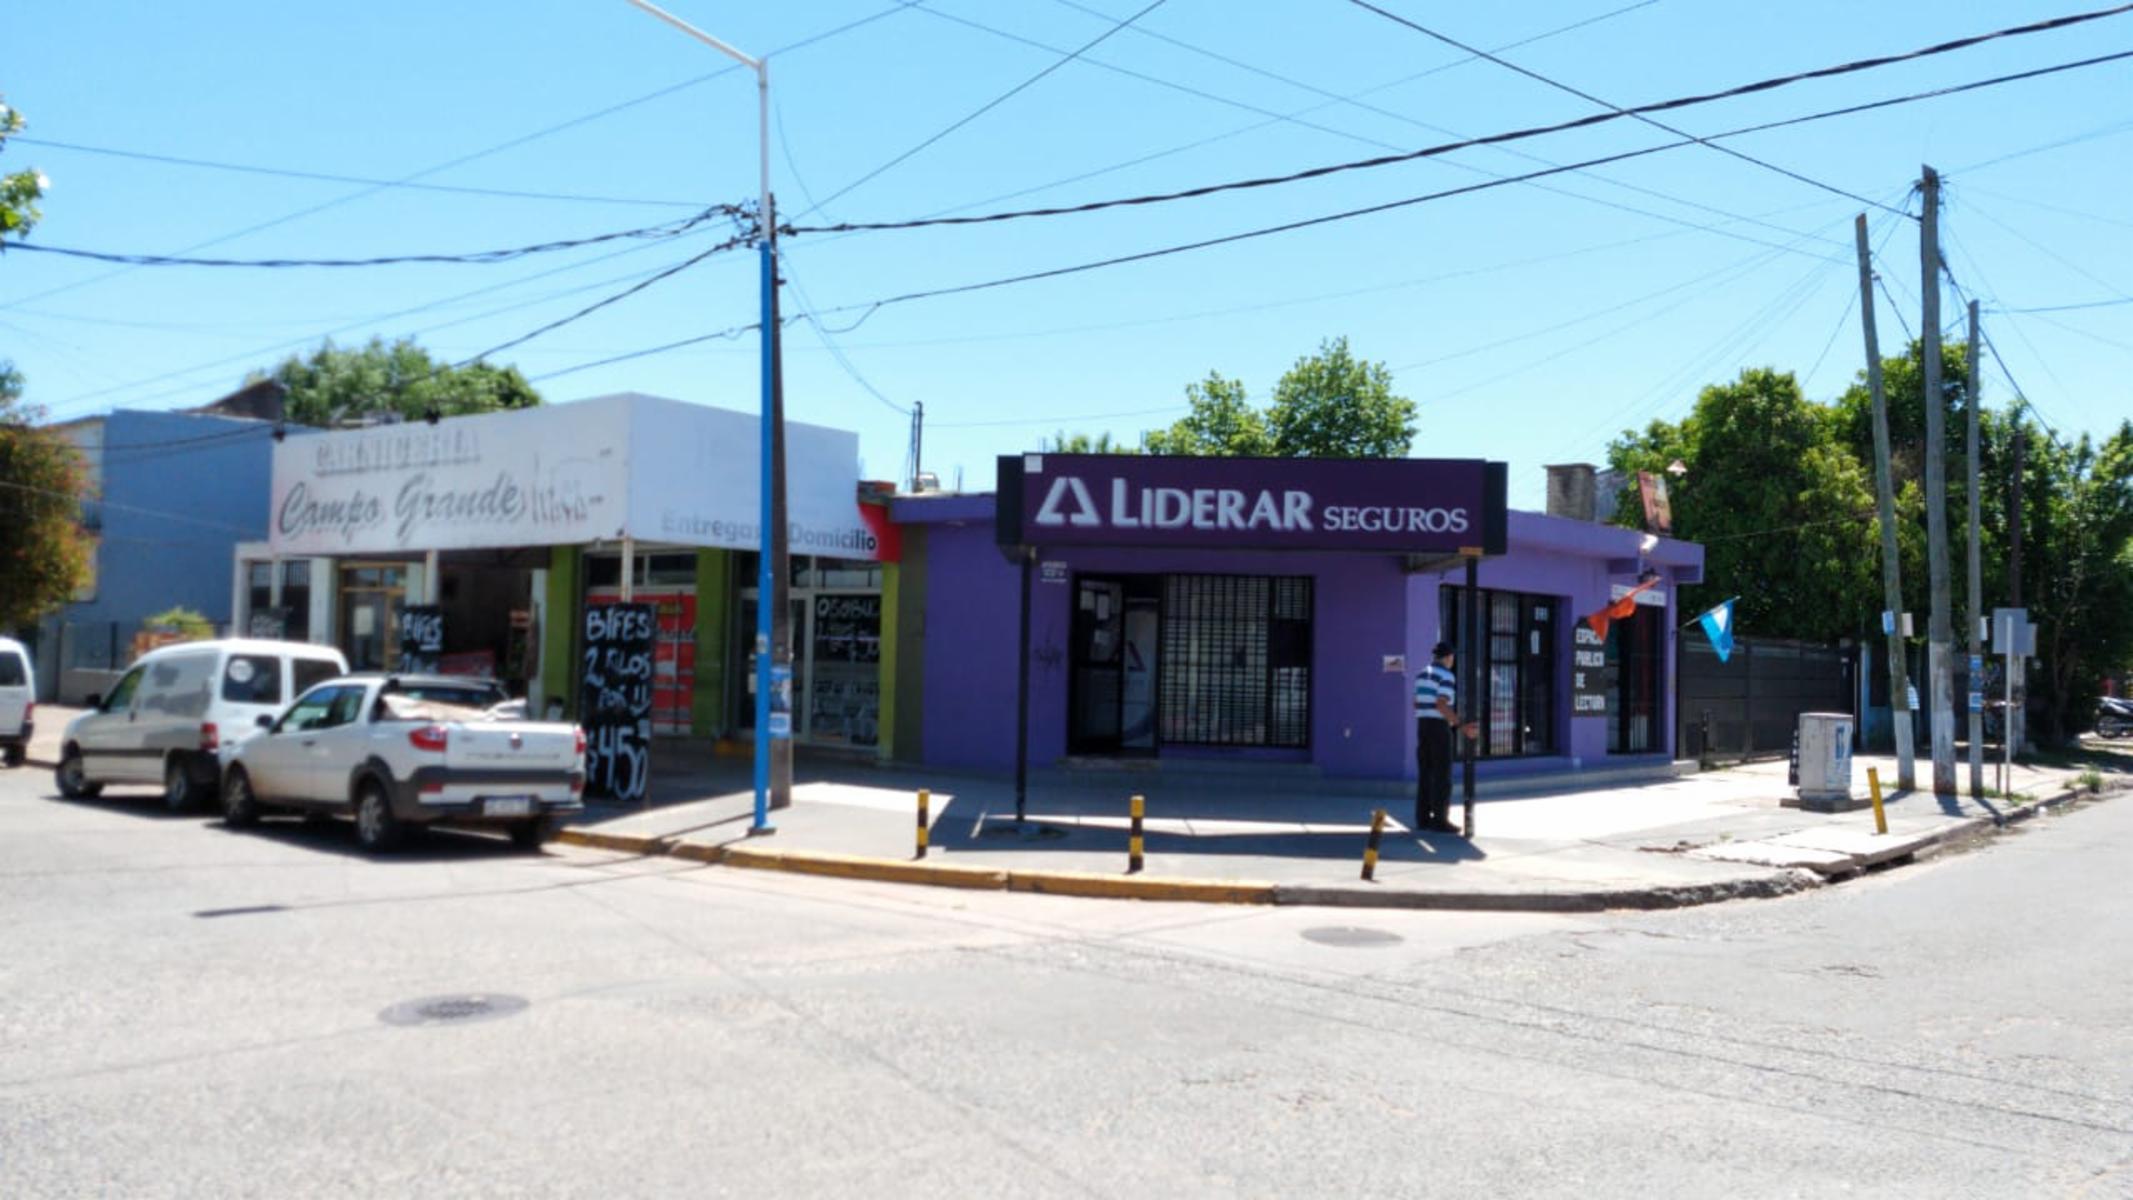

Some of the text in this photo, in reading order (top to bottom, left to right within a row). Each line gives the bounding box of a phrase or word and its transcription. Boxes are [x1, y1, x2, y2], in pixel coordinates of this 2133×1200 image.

[279, 481, 380, 537] Campo
[394, 471, 525, 537] Grande
[1323, 507, 1468, 533] SEGUROS
[788, 523, 877, 551] Domicilio
[586, 611, 650, 641] BIFES
